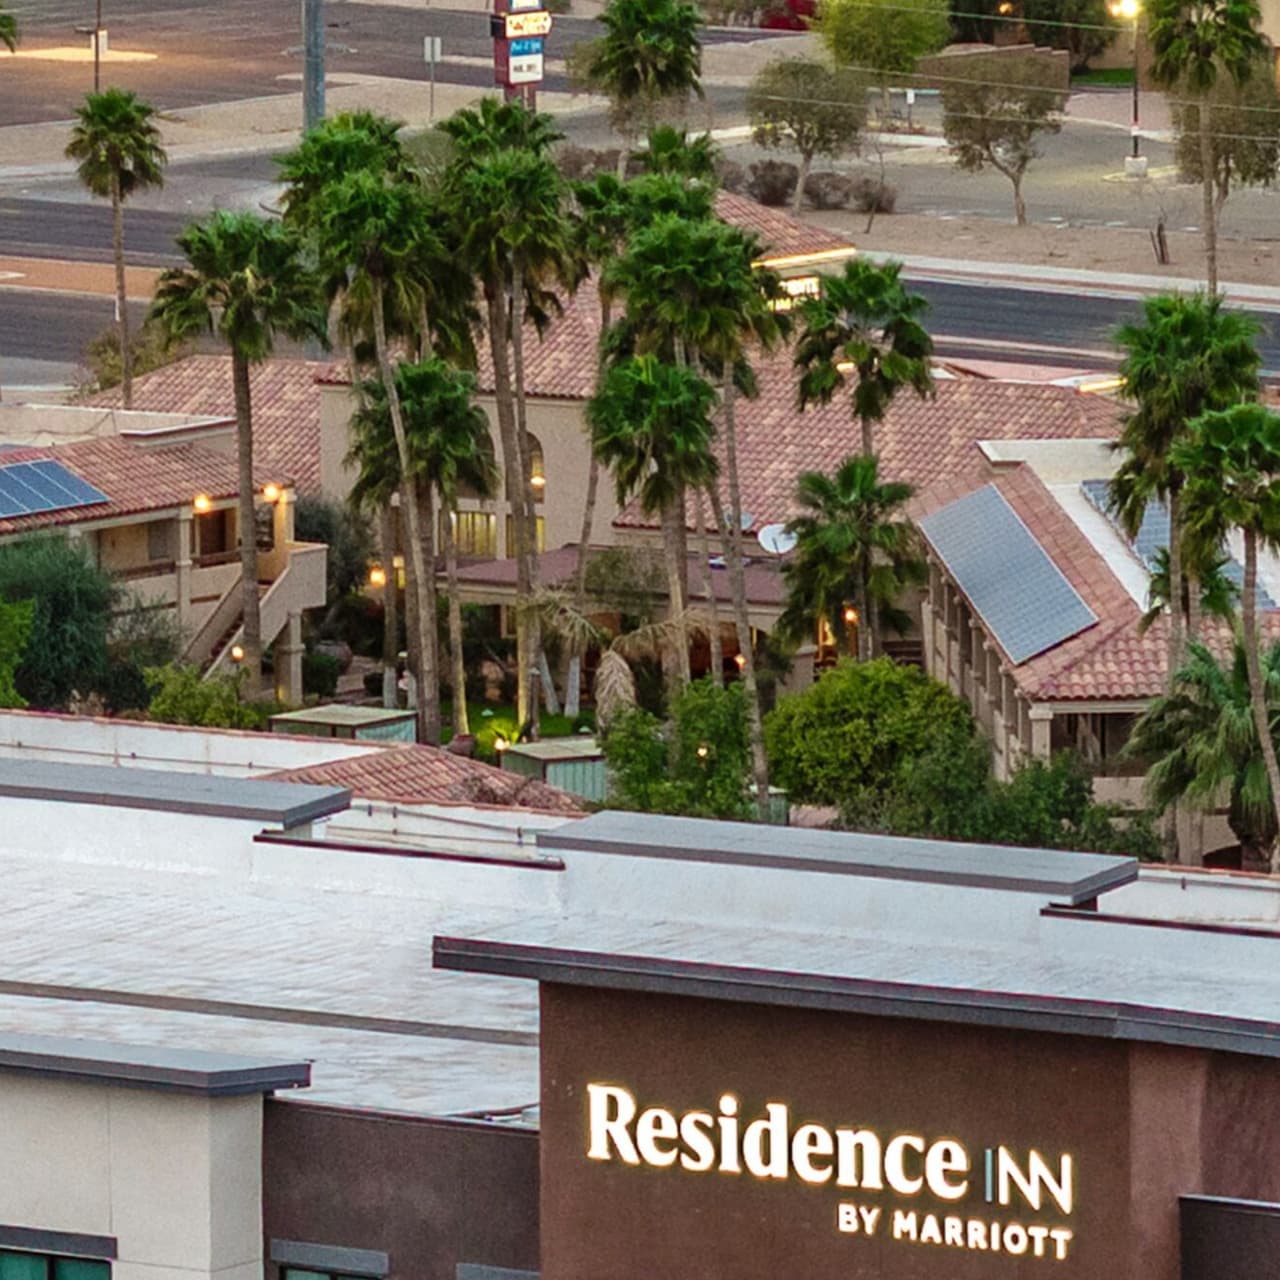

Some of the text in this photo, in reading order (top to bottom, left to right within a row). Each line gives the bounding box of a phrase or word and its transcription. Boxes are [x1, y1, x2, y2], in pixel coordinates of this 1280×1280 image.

[586, 1083, 1073, 1215] Residence INN
[837, 1203, 1074, 1260] BY MARRIOTT
